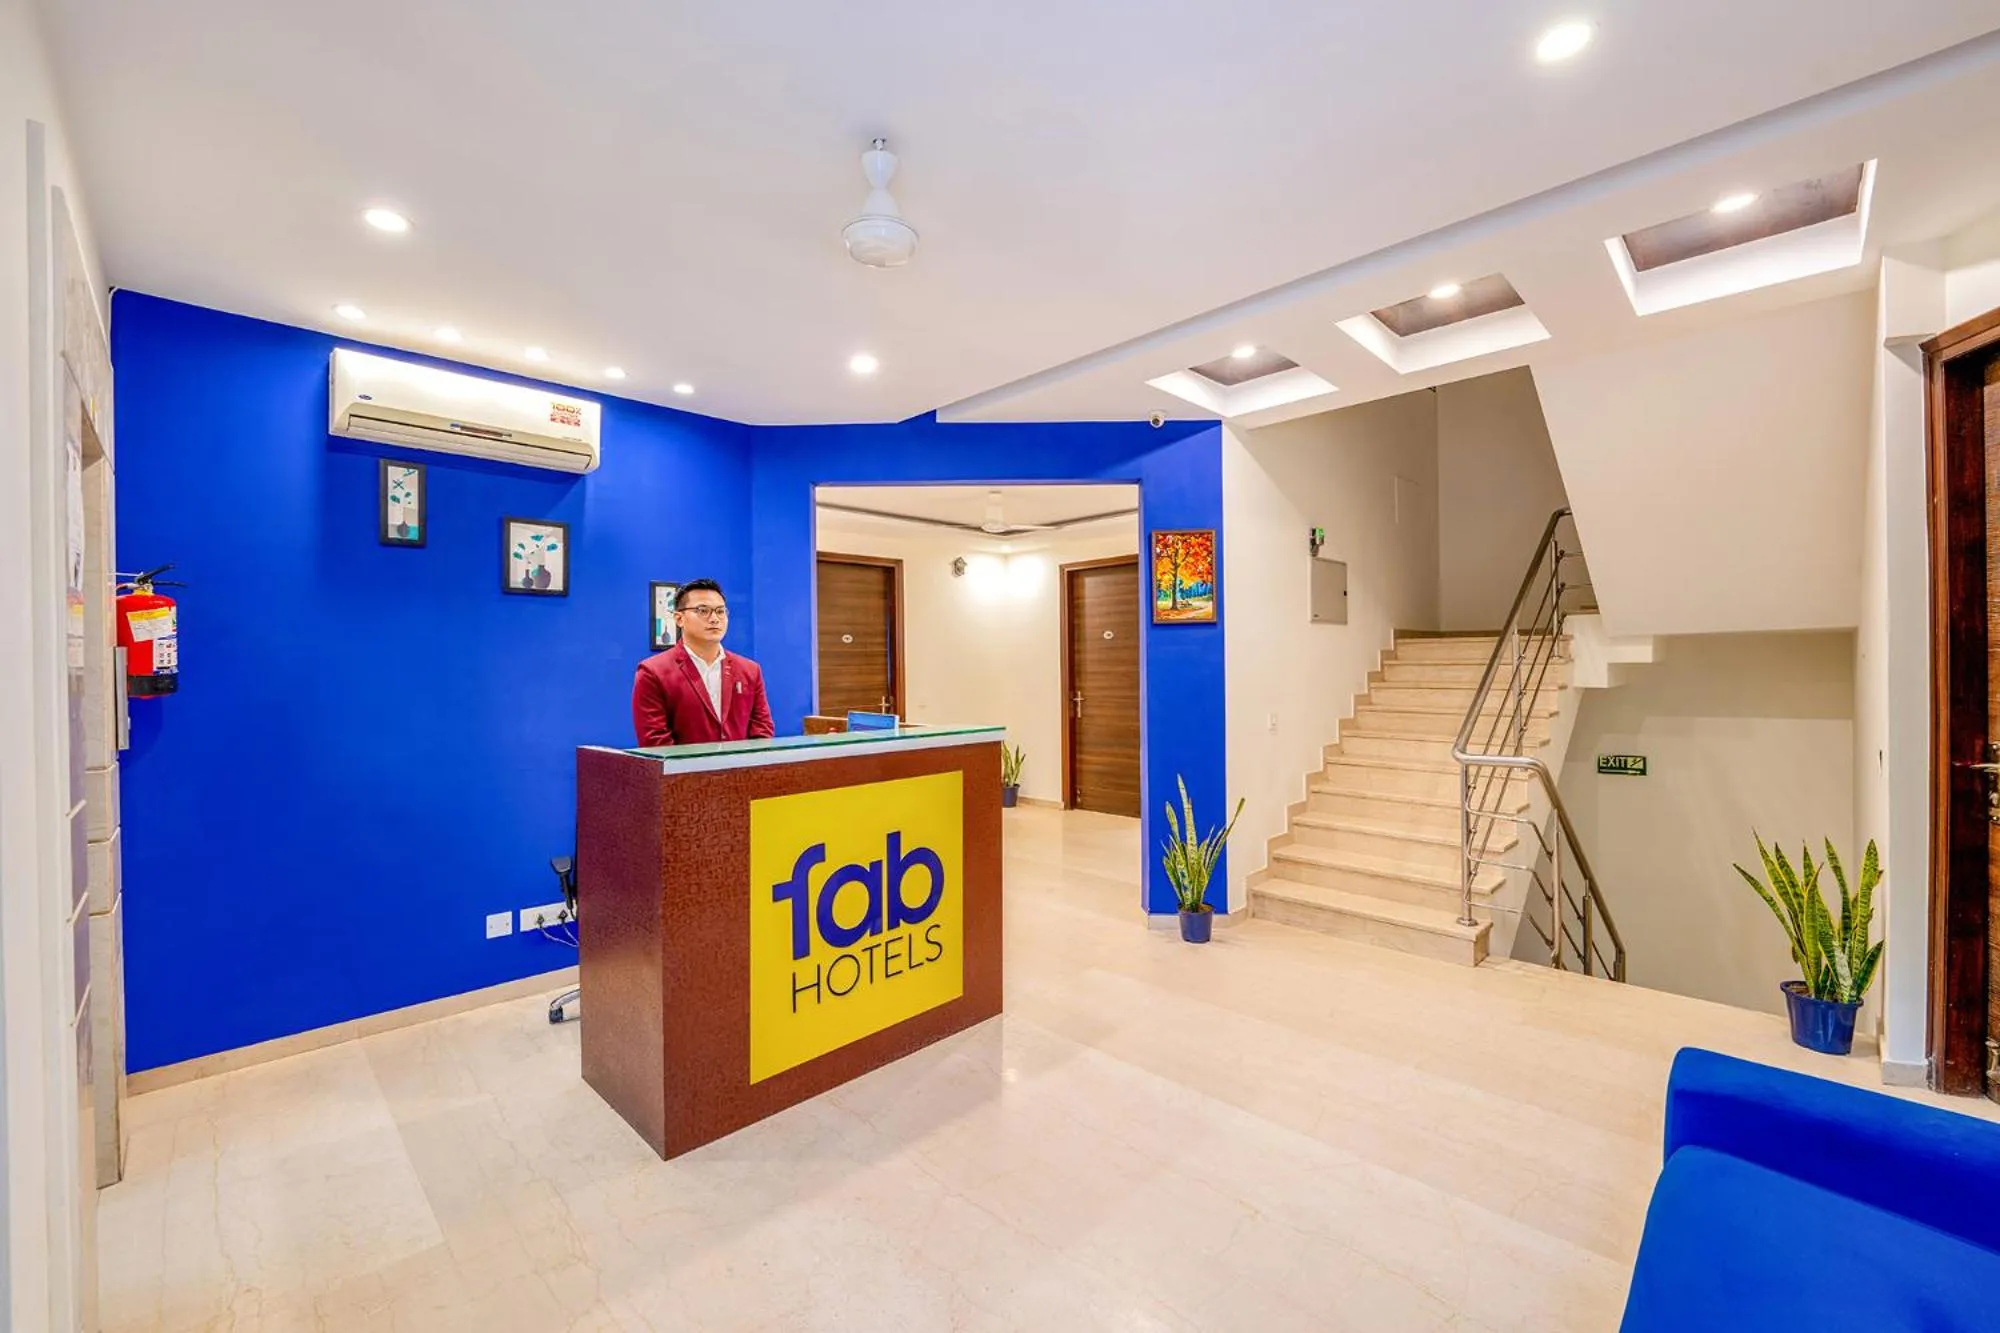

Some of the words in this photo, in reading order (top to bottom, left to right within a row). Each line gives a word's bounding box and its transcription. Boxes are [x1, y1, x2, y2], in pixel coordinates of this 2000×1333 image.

[1599, 756, 1625, 767] EXIT
[772, 830, 944, 960] fab
[792, 924, 943, 1013] HOTELS
